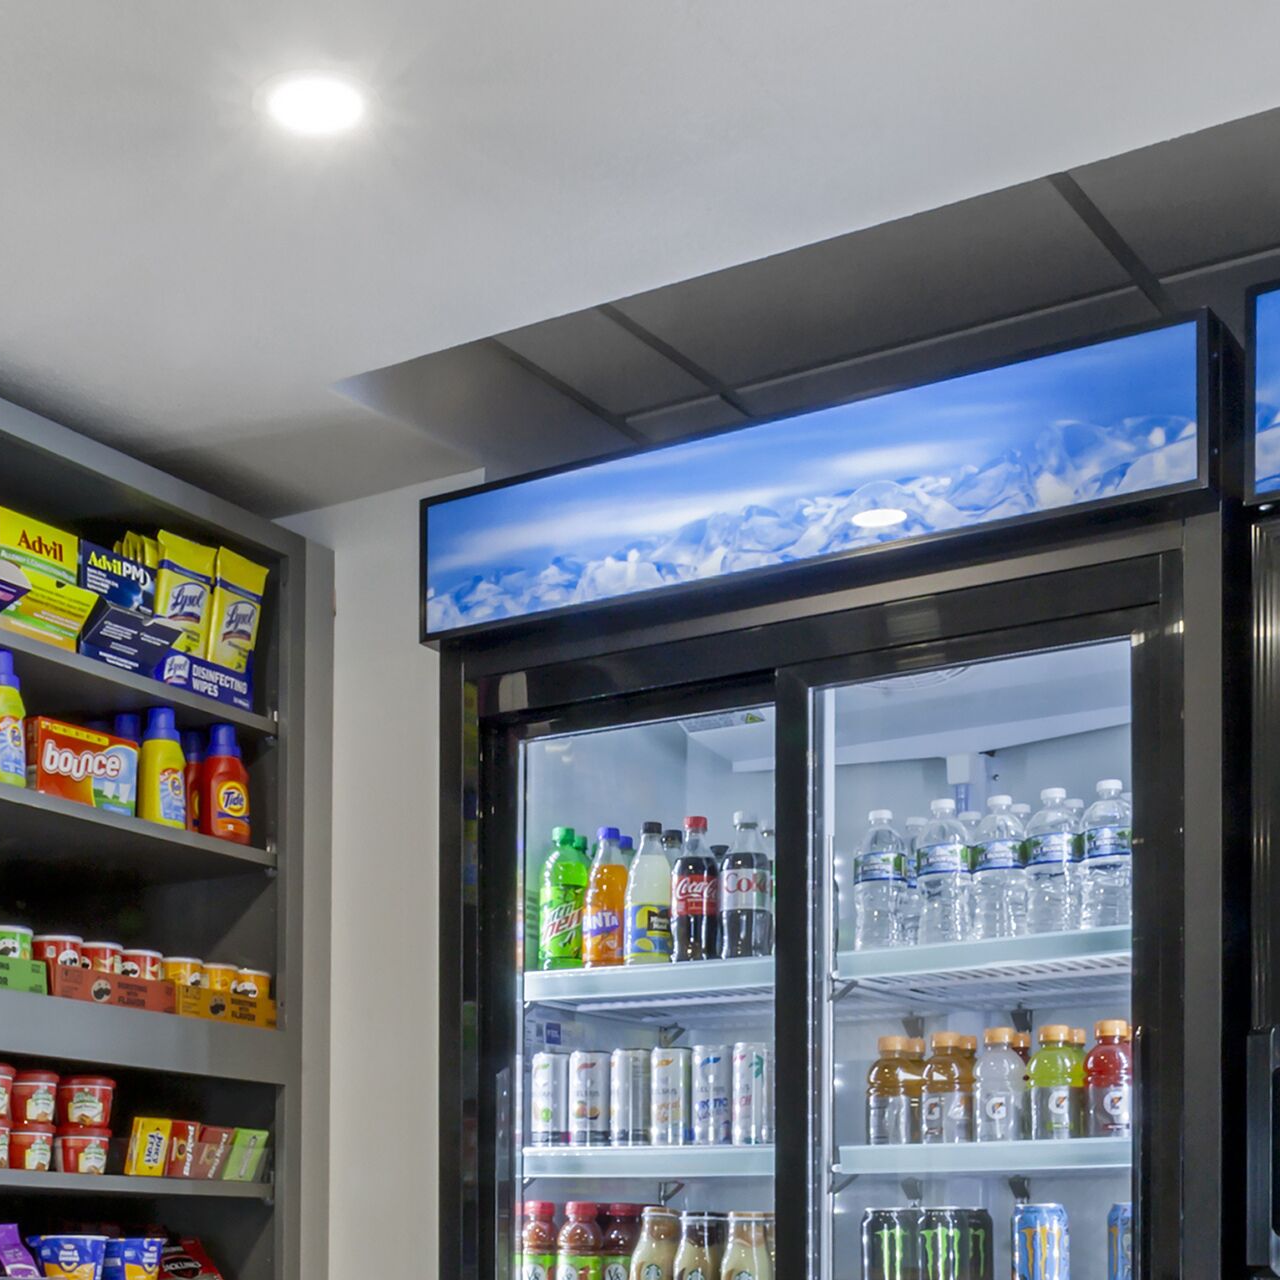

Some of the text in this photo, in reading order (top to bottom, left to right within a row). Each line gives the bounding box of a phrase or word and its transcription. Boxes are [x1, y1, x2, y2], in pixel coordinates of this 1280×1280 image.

[17, 530, 64, 562] Advil
[88, 551, 122, 575] Advil
[192, 664, 248, 694] DISINFECTING
[192, 677, 219, 697] WIPES
[42, 740, 121, 779] bounce
[221, 790, 245, 809] Tide
